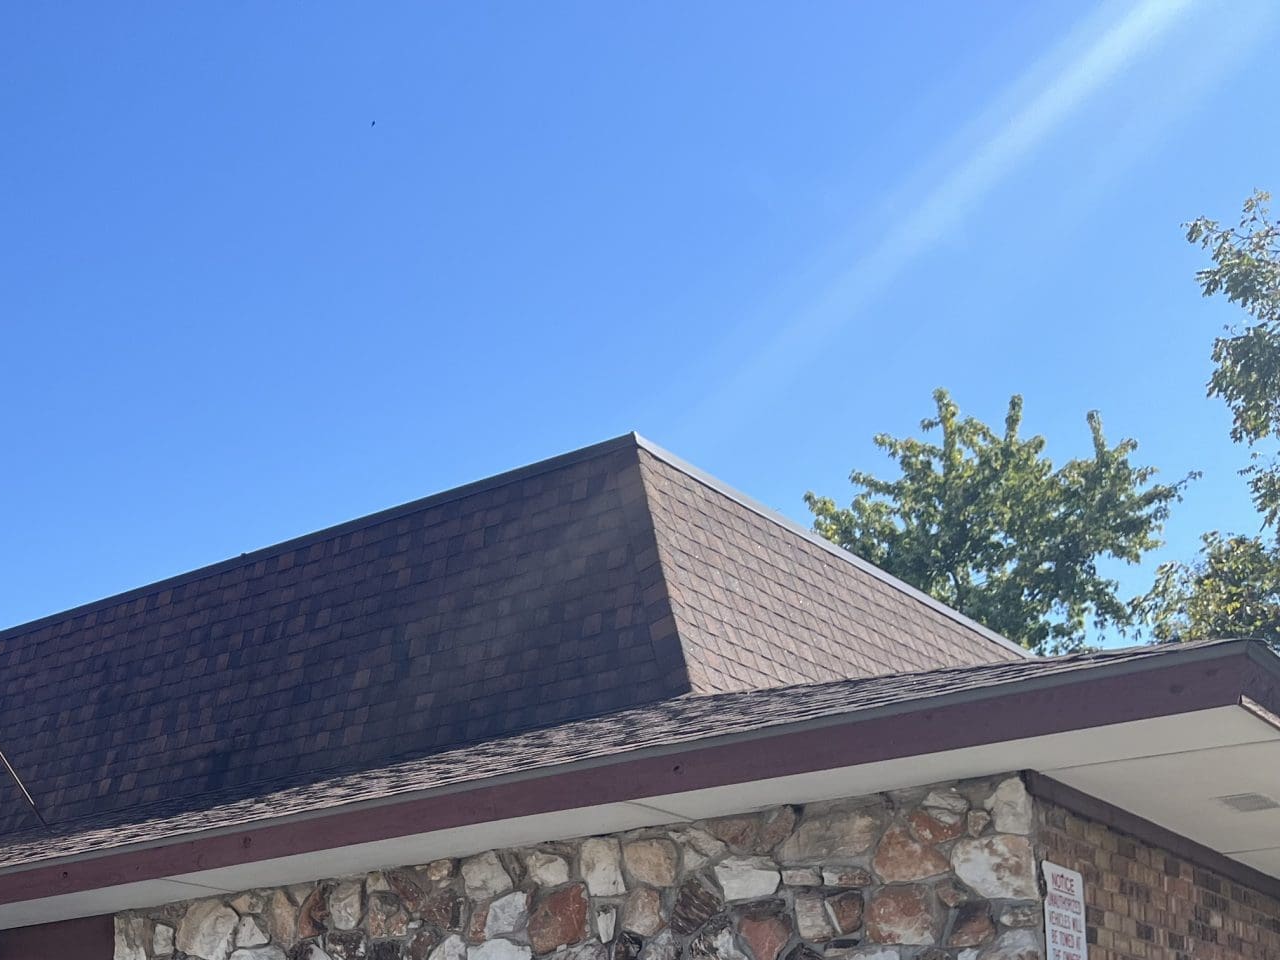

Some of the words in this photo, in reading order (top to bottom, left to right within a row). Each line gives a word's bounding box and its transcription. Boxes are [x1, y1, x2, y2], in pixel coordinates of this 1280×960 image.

[1051, 872, 1075, 893] NOTICE
[1051, 929, 1058, 945] BE
[1059, 931, 1075, 949] TOWED
